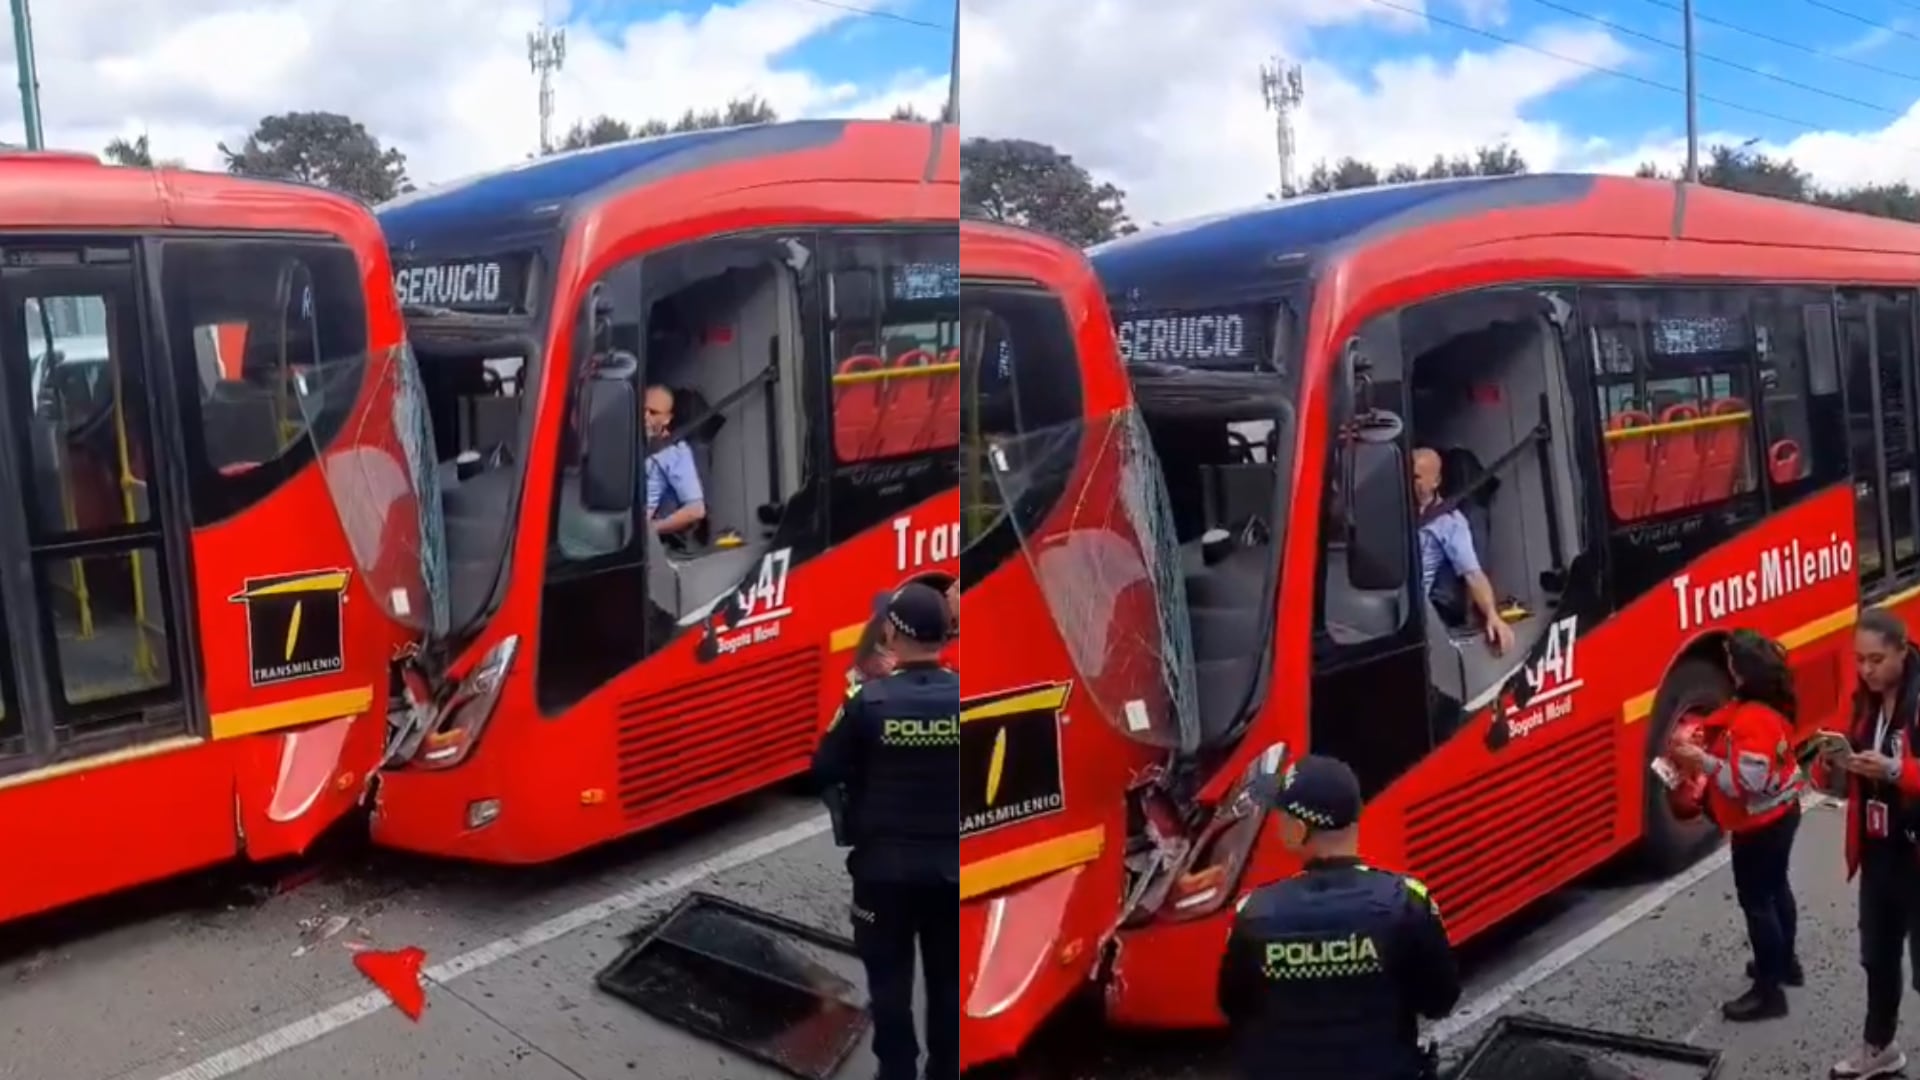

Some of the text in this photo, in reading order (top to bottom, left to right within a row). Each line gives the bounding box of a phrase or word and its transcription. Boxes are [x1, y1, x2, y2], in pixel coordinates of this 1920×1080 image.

[395, 262, 500, 305] SERVICIO
[1118, 314, 1243, 361] SERVICIO
[1673, 531, 1852, 630] TransMilenio
[254, 656, 341, 681] TRANSMILENIO
[884, 714, 960, 736] POLICÍ
[960, 793, 1061, 832] ANSMILENIO
[1266, 932, 1379, 966] POLICÍA
